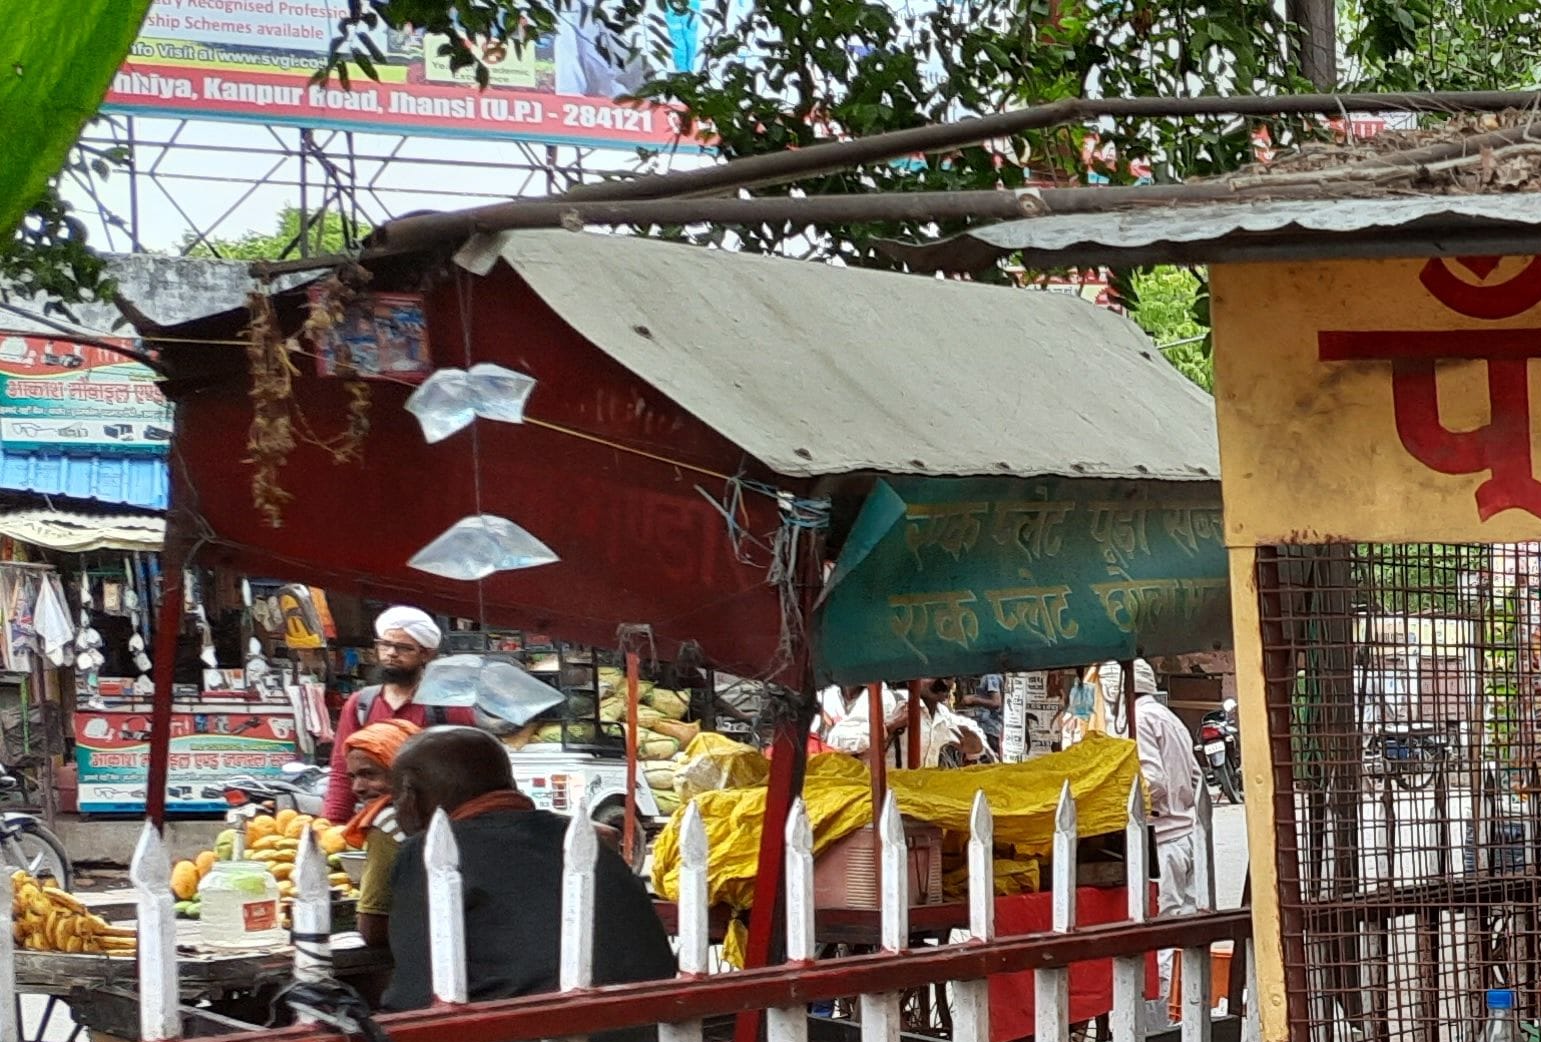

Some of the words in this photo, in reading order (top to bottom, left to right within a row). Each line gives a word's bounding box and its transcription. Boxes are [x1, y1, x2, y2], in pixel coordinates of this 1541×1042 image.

[279, 1, 348, 19] Professio
[184, 15, 253, 34] Schemes
[256, 22, 324, 39] available
[156, 43, 197, 61] Visit
[202, 76, 304, 107] Kanpur
[308, 84, 384, 115] Road,
[388, 90, 475, 120] Jhansi
[562, 103, 653, 133] 284121
